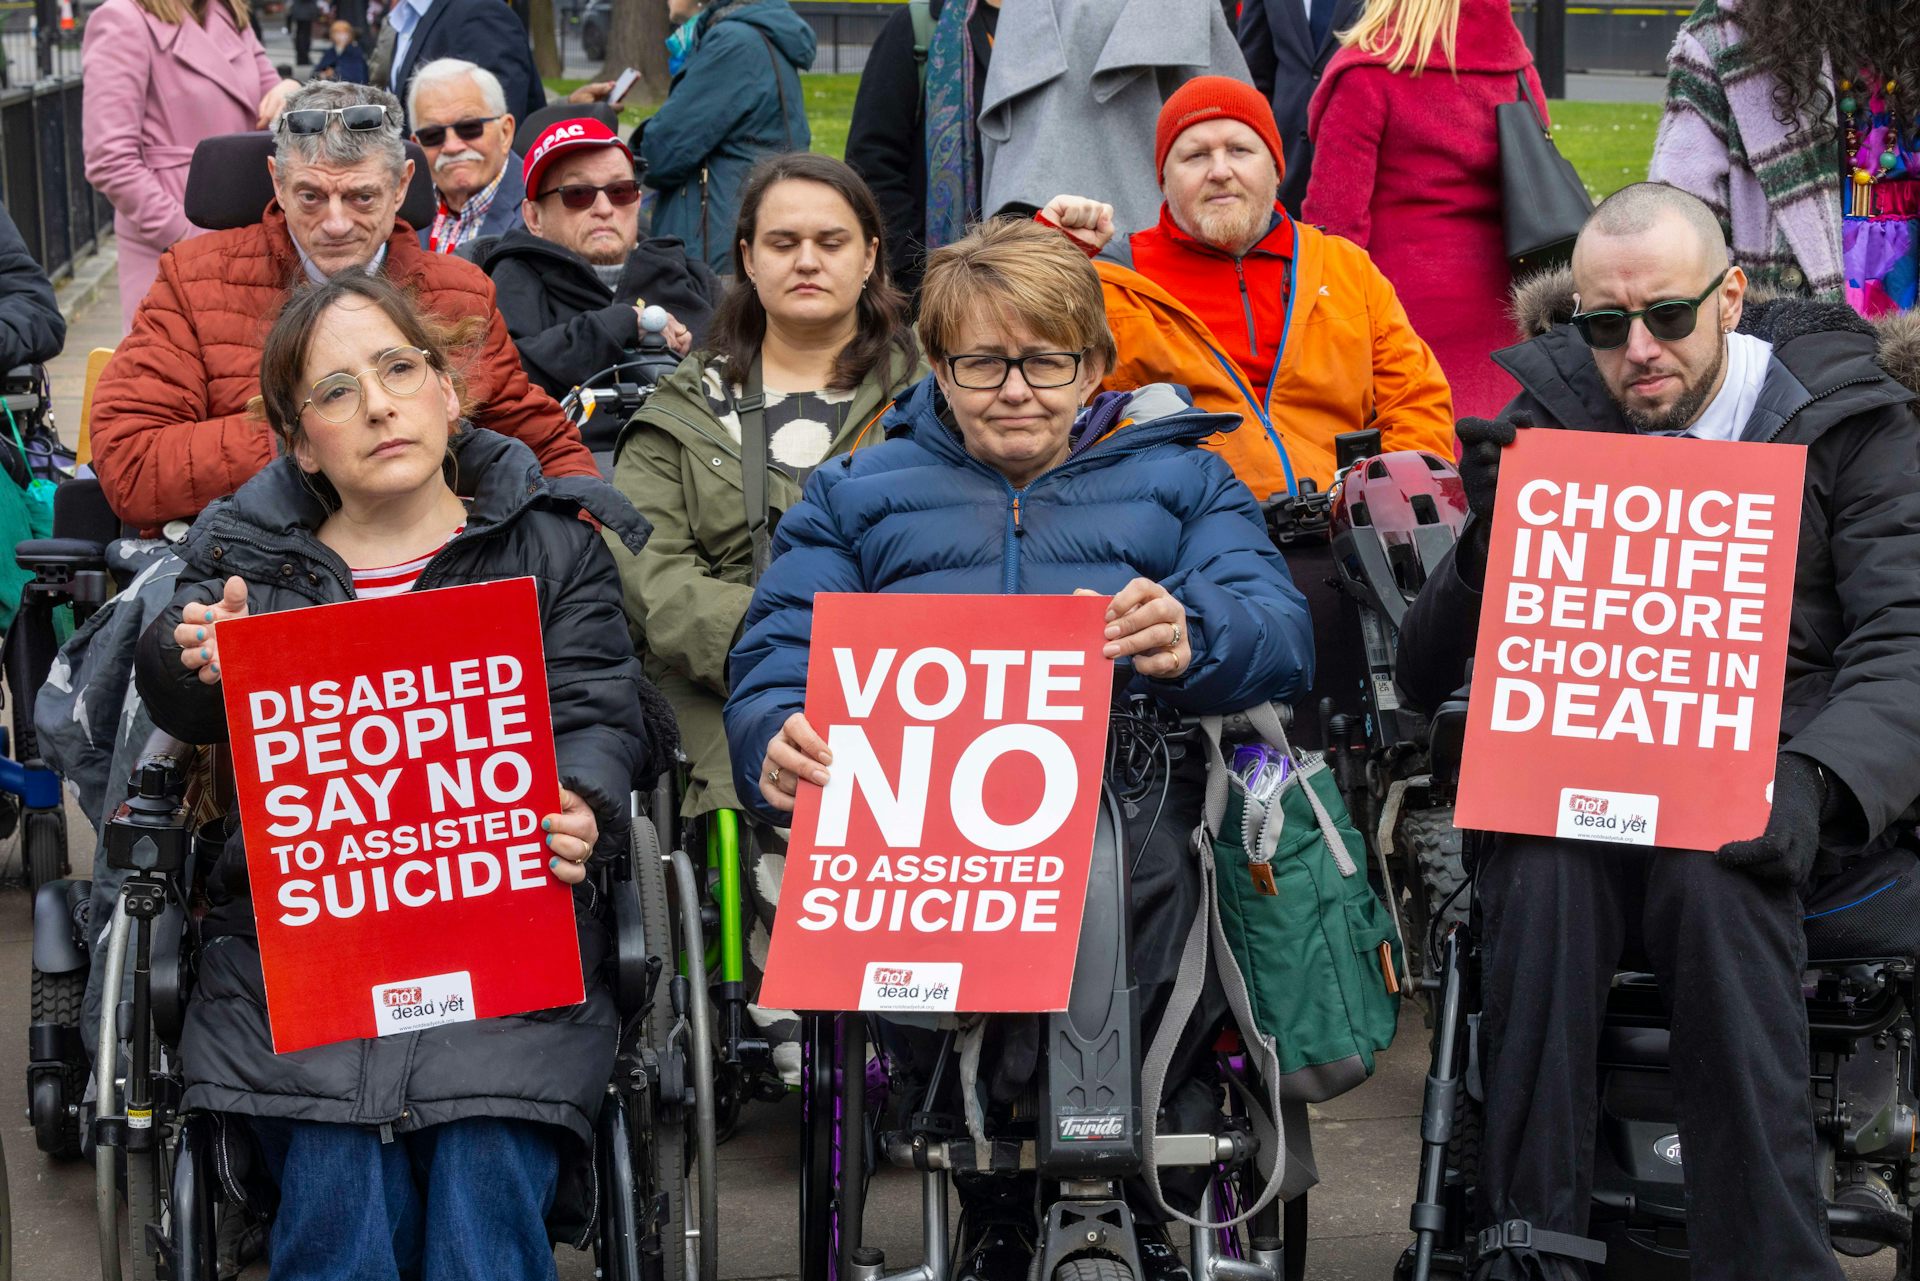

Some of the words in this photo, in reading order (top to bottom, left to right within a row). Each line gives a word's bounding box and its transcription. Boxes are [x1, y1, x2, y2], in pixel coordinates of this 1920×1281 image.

[1516, 478, 1776, 541] CHOICE
[1511, 527, 1589, 582] IN
[1610, 534, 1769, 595] LIFE
[1504, 581, 1765, 642] BEFORE
[831, 646, 1086, 722] VOTE
[1497, 635, 1692, 685] CHOICE
[1706, 651, 1760, 690] IN
[248, 655, 523, 730] DISABLED
[1489, 676, 1755, 752] DEATH
[253, 694, 533, 783] PEOPLE
[265, 767, 403, 838] SAY
[426, 750, 533, 813] NO
[813, 723, 1079, 852] NO
[1576, 797, 1603, 813] not
[270, 840, 325, 874] TO
[337, 808, 538, 865] ASSISTED
[1574, 812, 1617, 829] dead
[1620, 817, 1648, 835] yet
[277, 842, 547, 927] SUICIDE
[809, 853, 858, 883] TO
[865, 854, 1065, 884] ASSISTED
[796, 887, 1061, 933] SUICIDE
[389, 987, 417, 1005] not
[446, 994, 459, 1003] UK
[877, 983, 919, 998] dead
[922, 985, 950, 1002] yet
[879, 970, 907, 985] not
[391, 998, 434, 1021] dead
[439, 997, 465, 1017] yet
[1060, 1116, 1122, 1136] Triride
